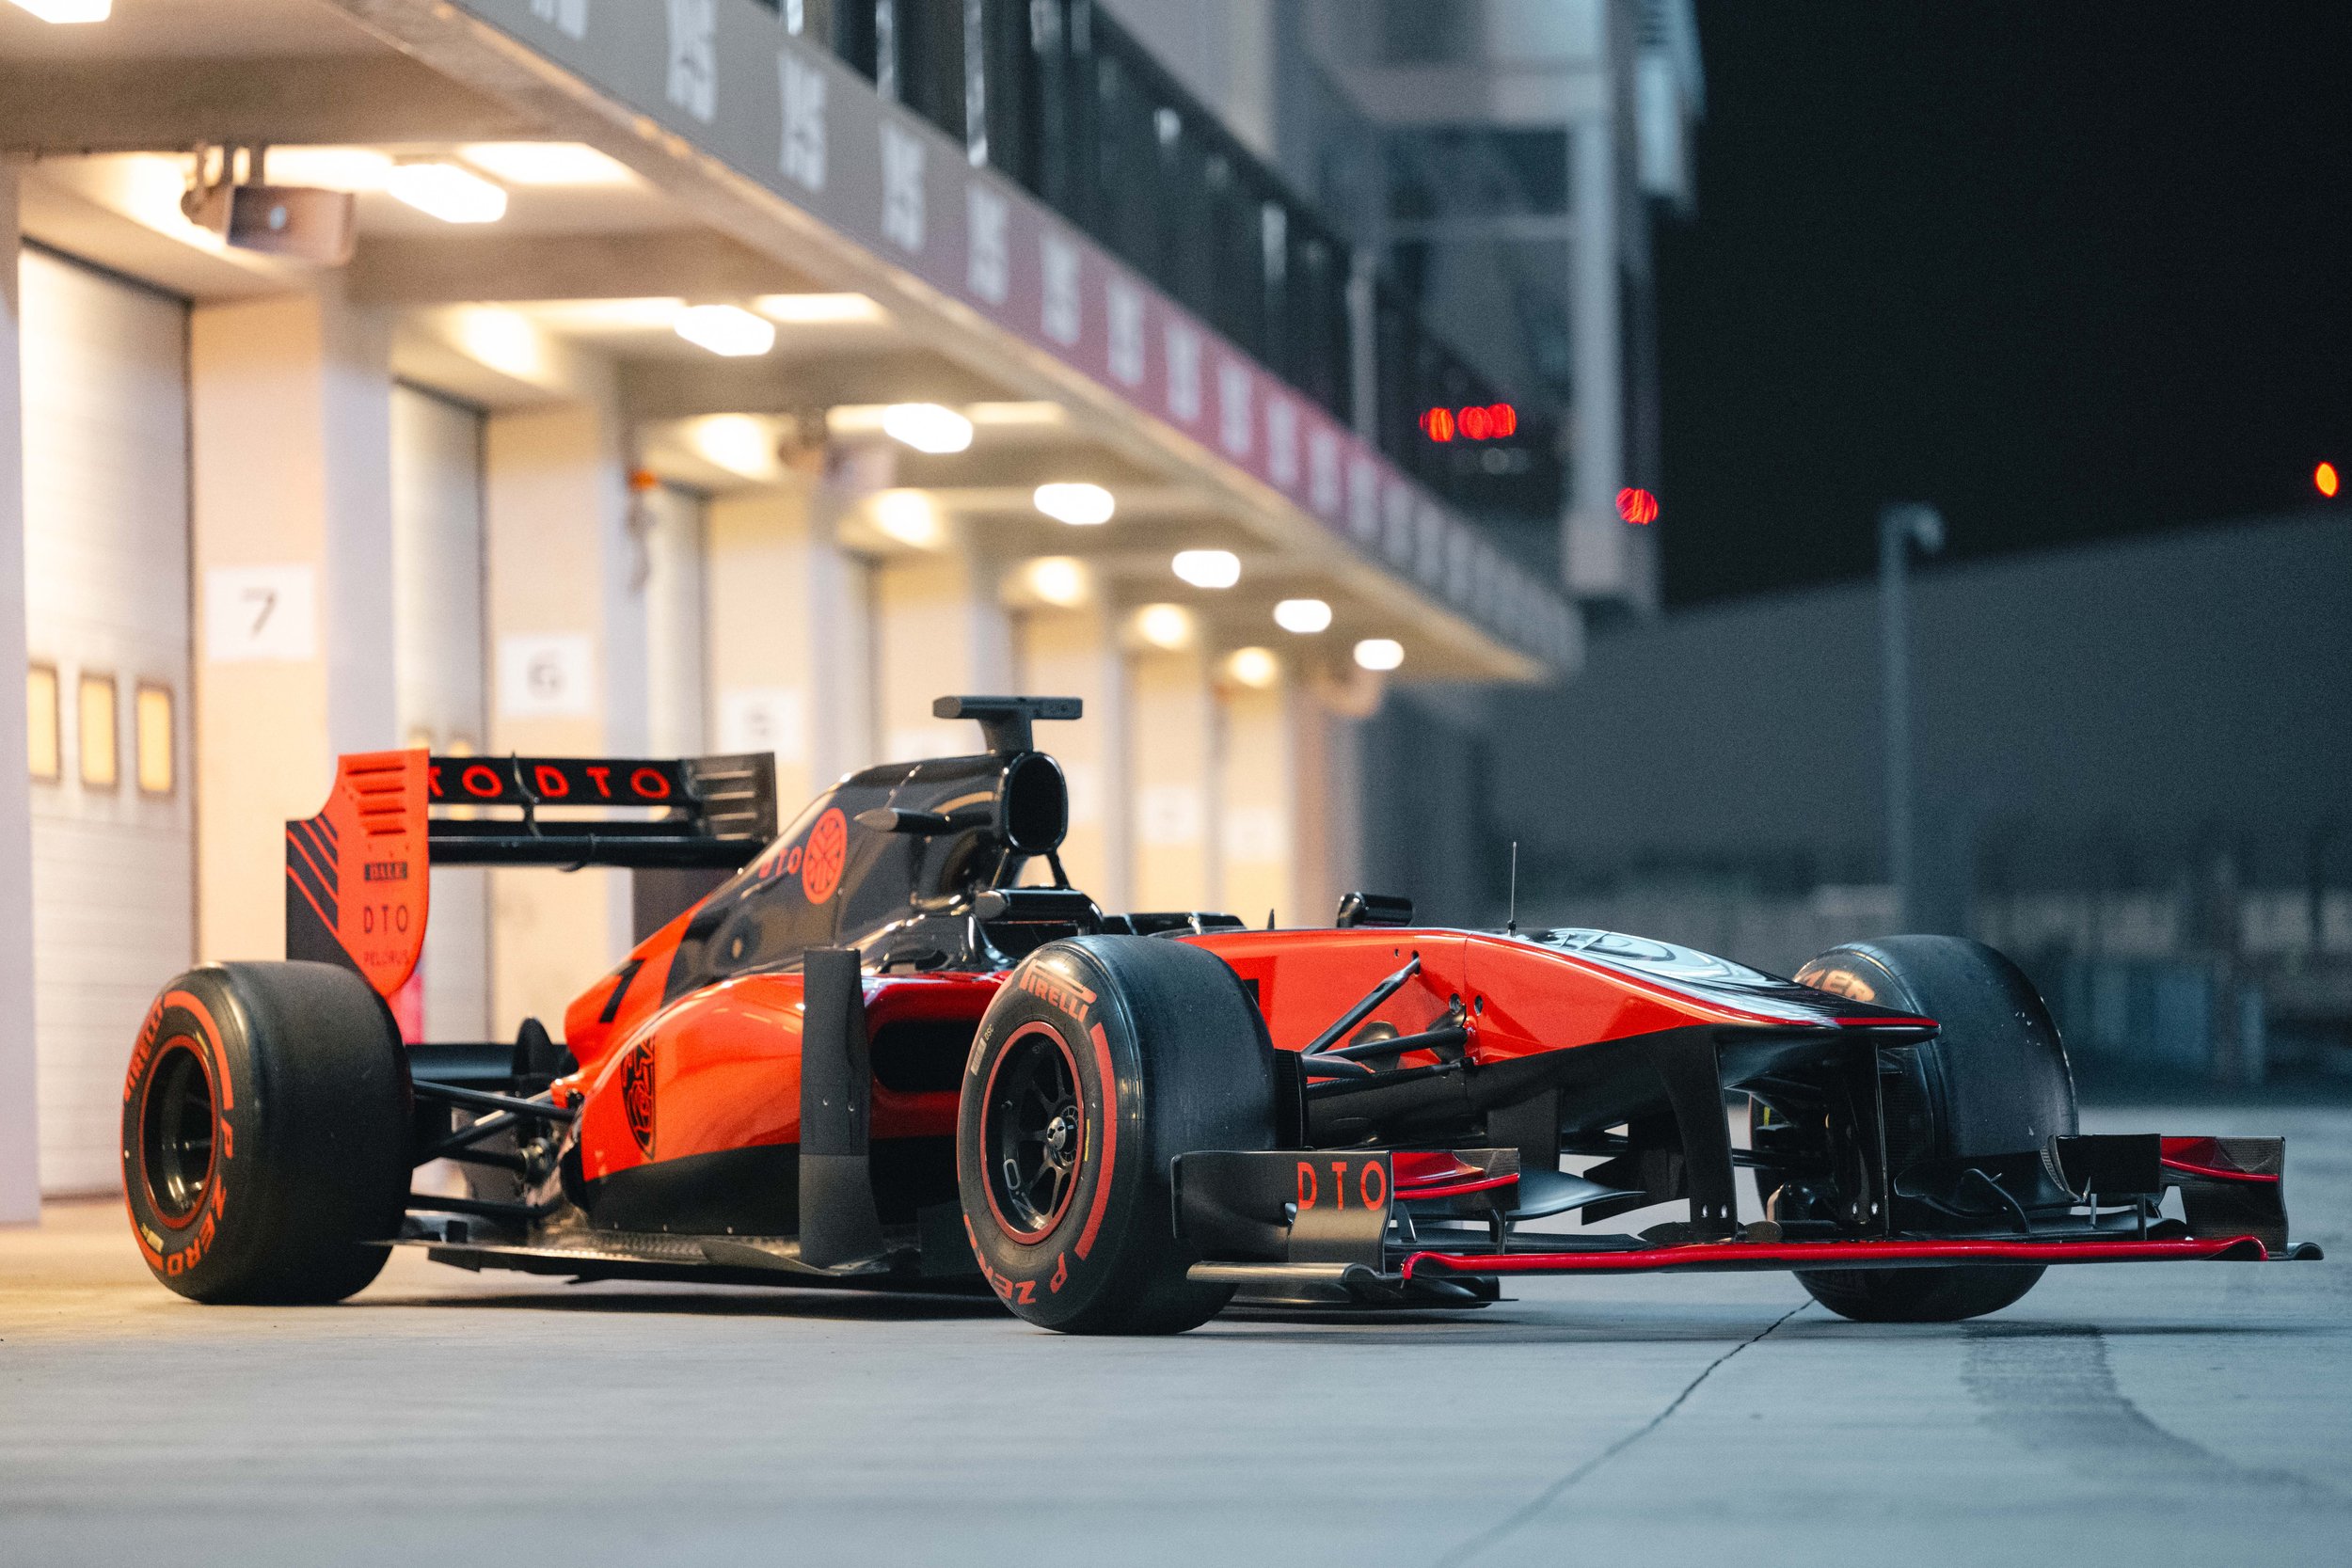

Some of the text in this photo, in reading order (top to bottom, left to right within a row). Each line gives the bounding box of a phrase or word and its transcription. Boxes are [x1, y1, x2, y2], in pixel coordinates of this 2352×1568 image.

[428, 765, 671, 799] TO DTO
[363, 904, 408, 934] DTO
[1019, 959, 1098, 1023] PIRELLI
[1297, 1160, 1387, 1212] DTO
